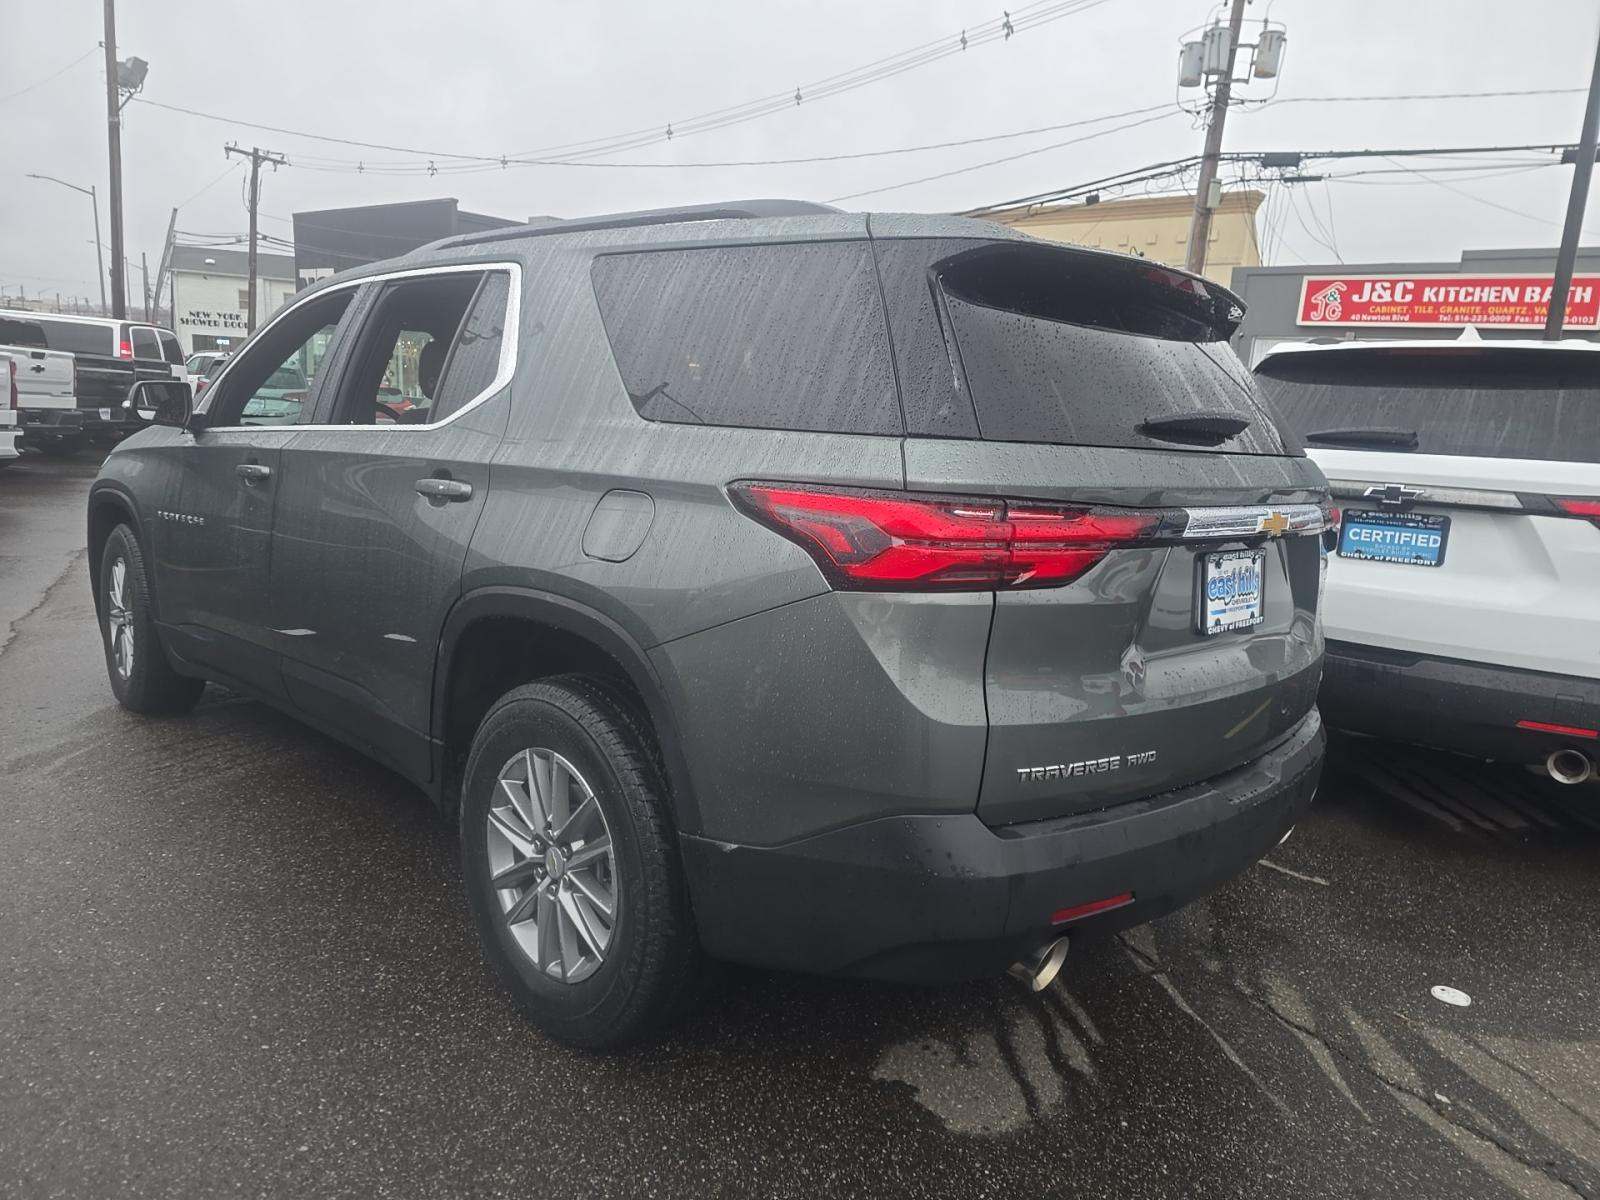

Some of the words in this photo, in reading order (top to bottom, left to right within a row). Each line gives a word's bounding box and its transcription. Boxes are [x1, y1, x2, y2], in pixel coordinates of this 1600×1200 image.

[1352, 281, 1414, 303] J&C
[1423, 286, 1520, 303] KITCHEN
[180, 317, 219, 327] SHOWER
[189, 310, 210, 318] NEW
[216, 312, 242, 321] YORK
[1348, 528, 1441, 548] CERTIFIED
[1340, 551, 1373, 560] CHEVY
[1385, 556, 1438, 566] FREEPORT
[1208, 624, 1229, 635] CHEVY
[1235, 616, 1264, 629] FREEPORT
[1016, 756, 1120, 783] TRAVERSE
[1126, 750, 1157, 767] AWD
